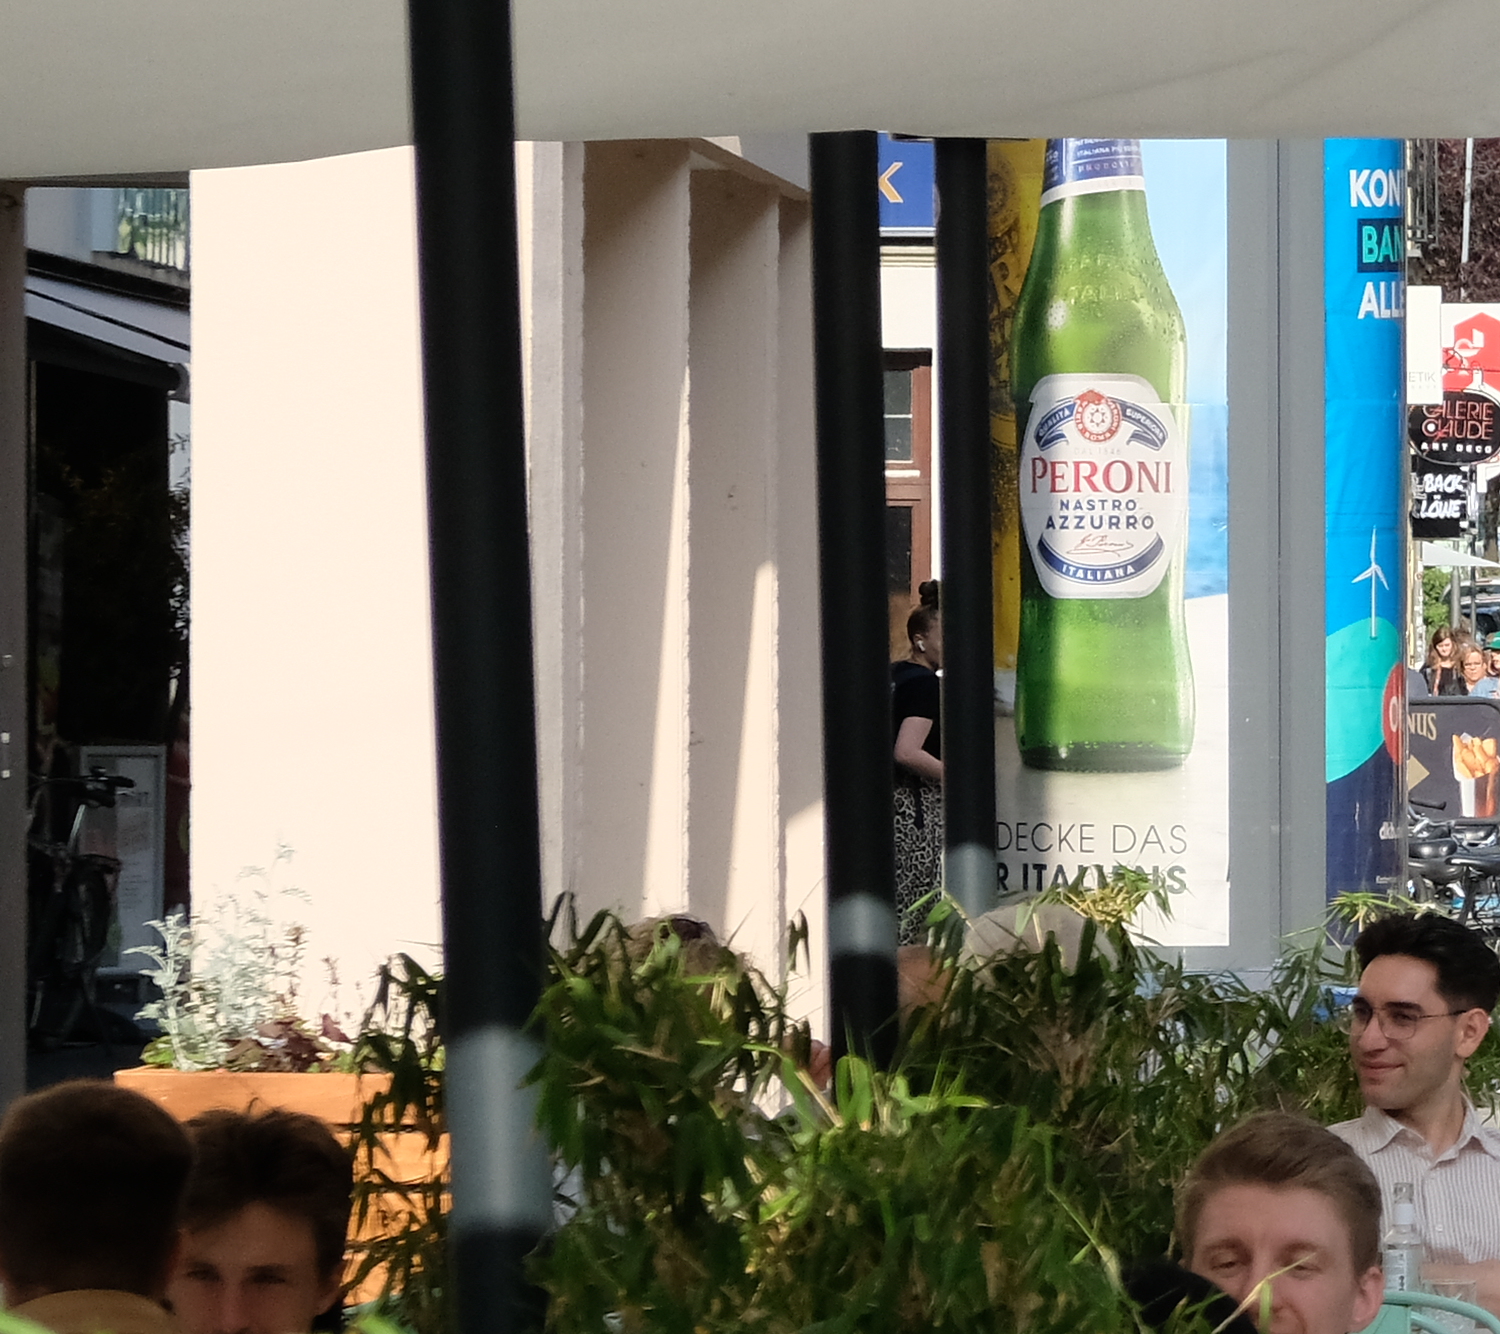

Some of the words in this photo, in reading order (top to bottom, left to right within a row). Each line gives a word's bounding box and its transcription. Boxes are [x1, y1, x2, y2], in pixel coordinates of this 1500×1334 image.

[1031, 455, 1174, 494] PERONI
[1060, 499, 1138, 512] NASTRO
[1045, 515, 1155, 530] AZZURRO
[1062, 564, 1136, 582] ITALIANA
[1112, 824, 1187, 854] DAS
